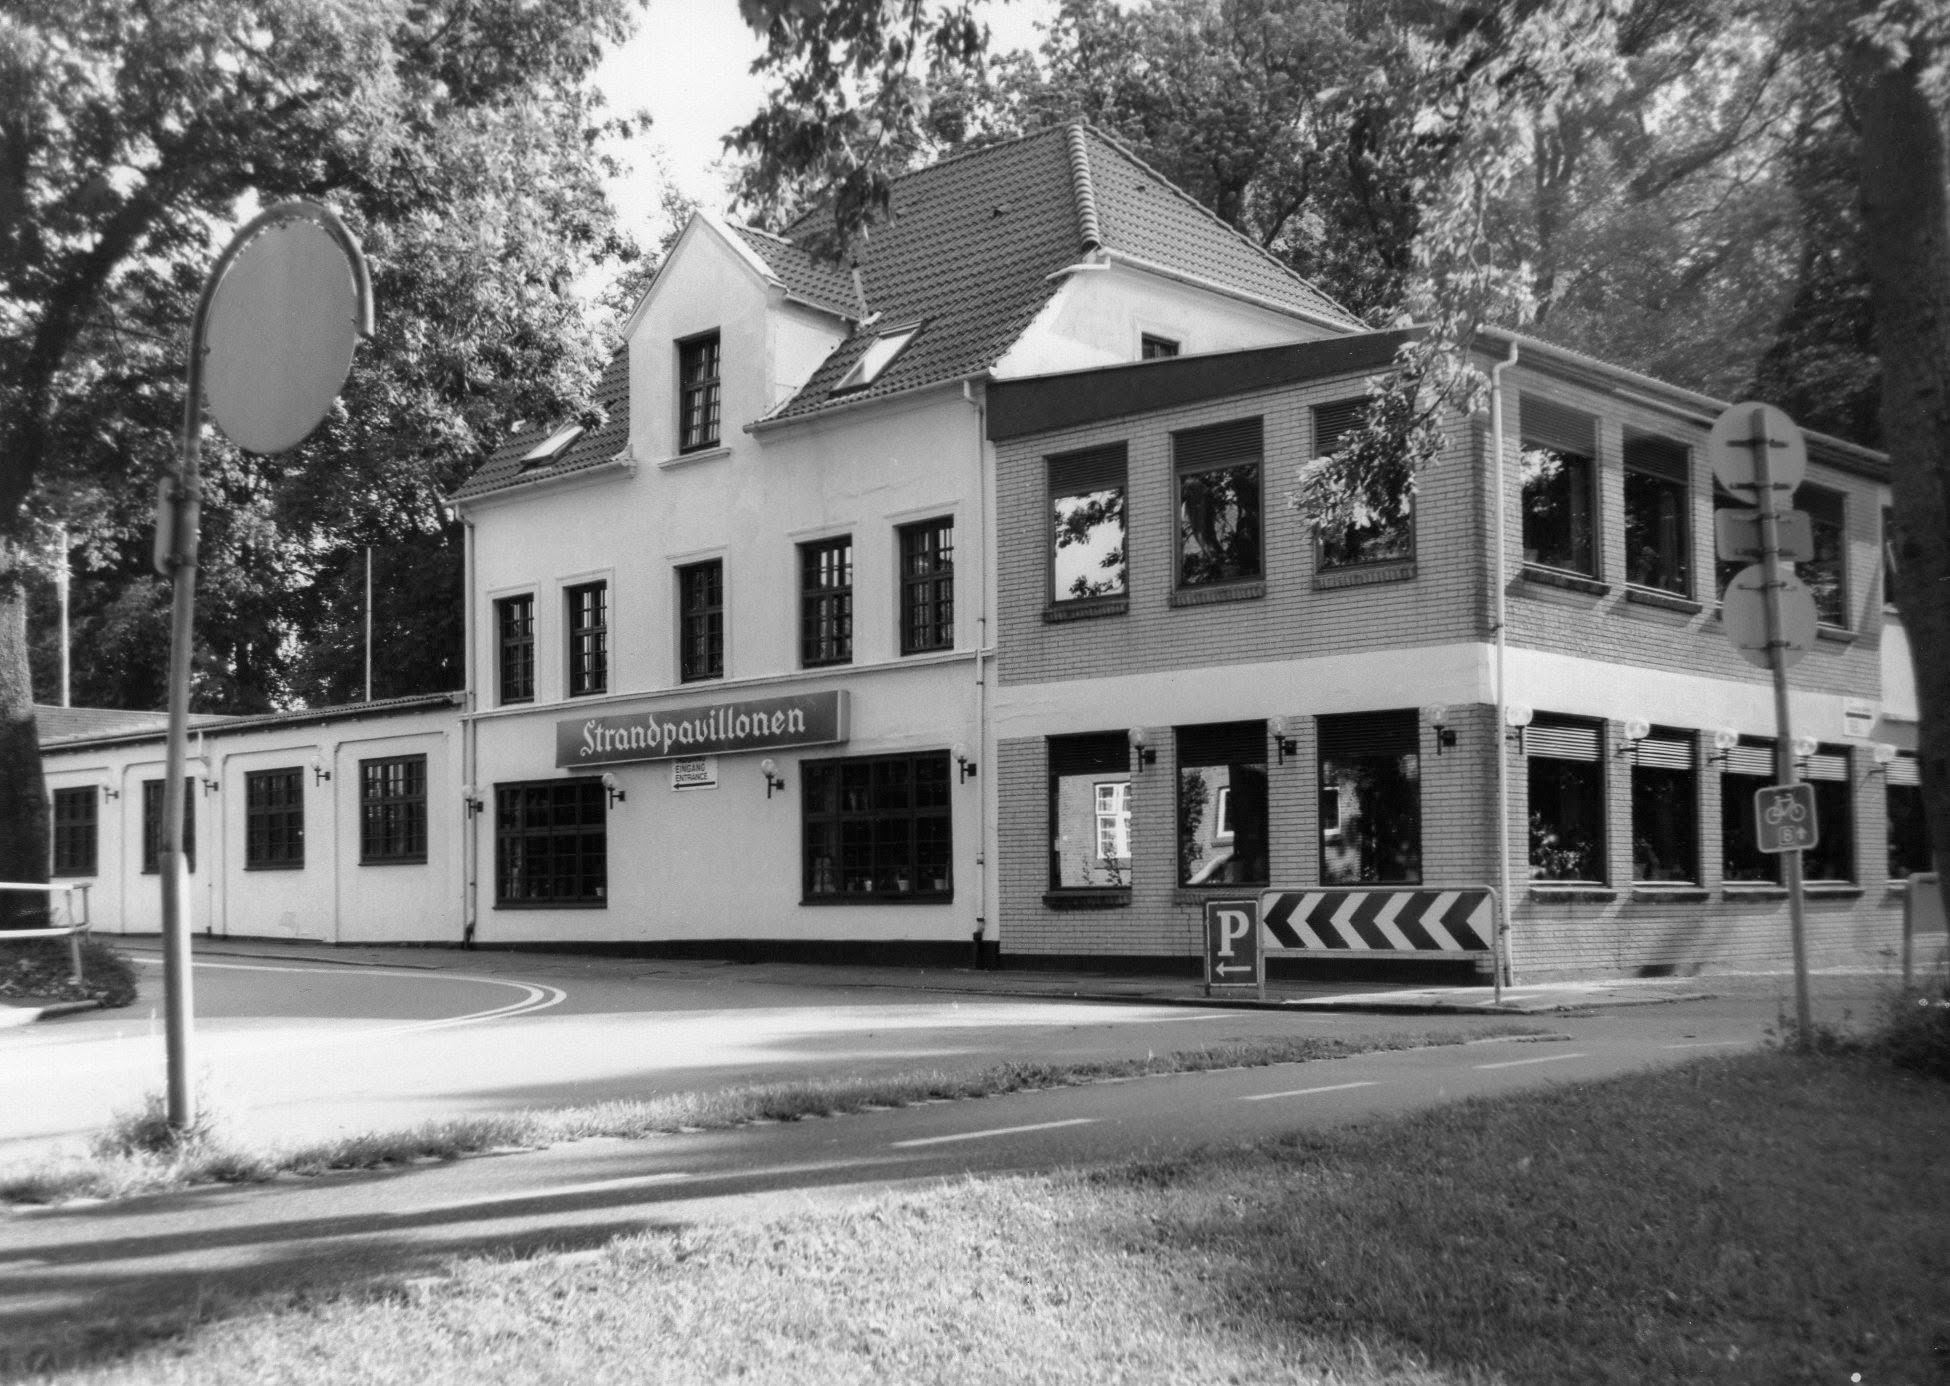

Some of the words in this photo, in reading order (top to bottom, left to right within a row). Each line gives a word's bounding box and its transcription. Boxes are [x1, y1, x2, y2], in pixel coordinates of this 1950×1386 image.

[580, 706, 806, 756] Strandpavillonen
[675, 763, 706, 773] EINGANG
[675, 772, 708, 782] ENTRANCE
[1216, 909, 1250, 957] P
